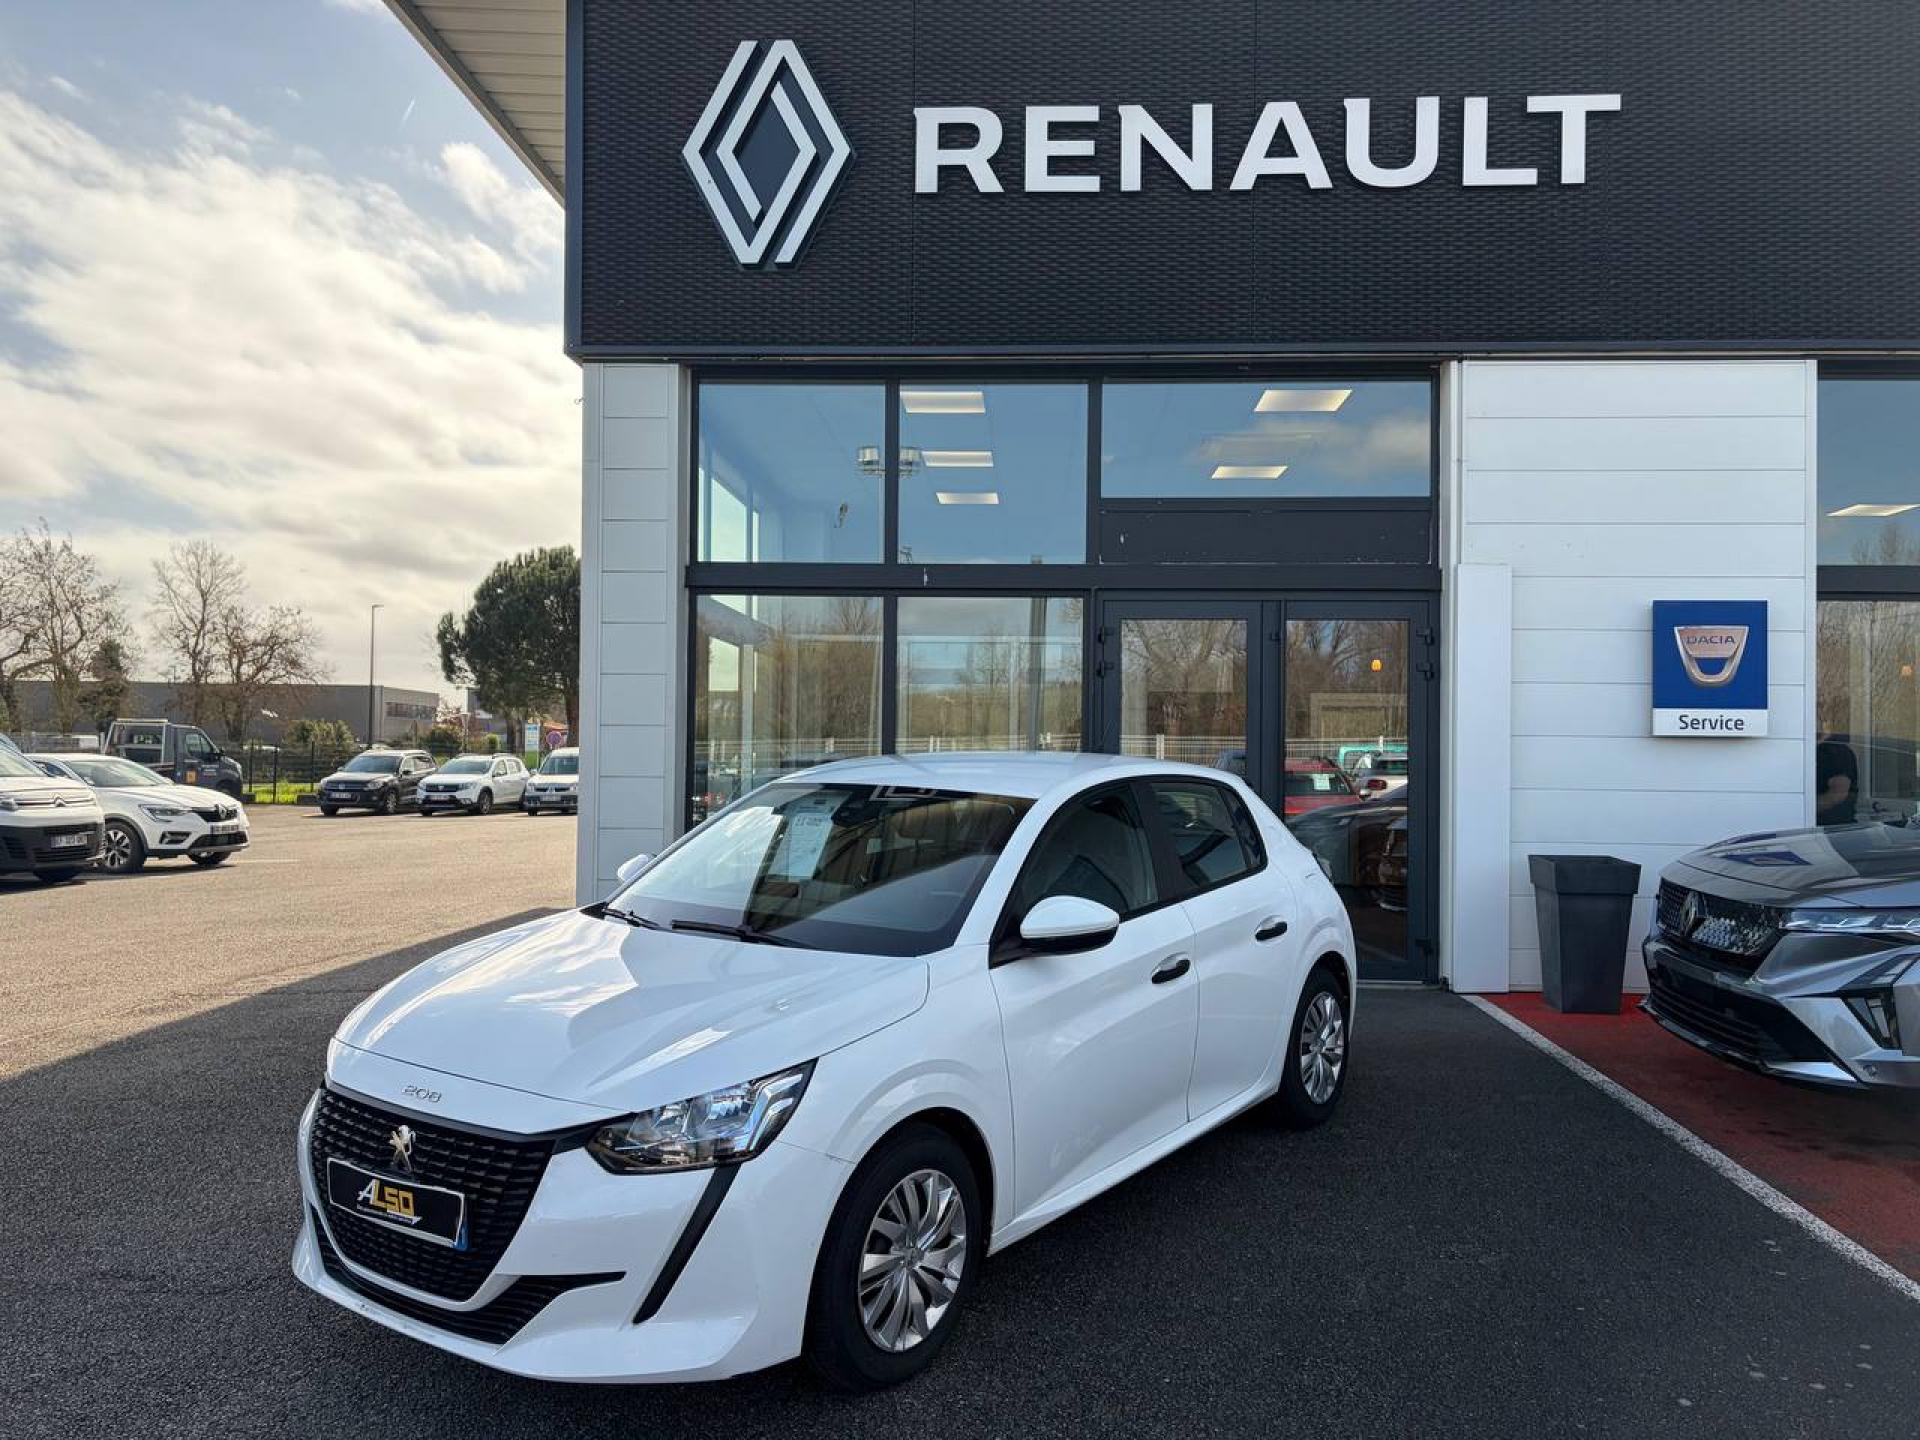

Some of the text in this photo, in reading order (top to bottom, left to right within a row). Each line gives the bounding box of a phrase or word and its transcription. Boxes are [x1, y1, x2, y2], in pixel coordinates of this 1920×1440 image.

[914, 94, 1622, 194] RENAULT
[1686, 635, 1736, 645] DACIA
[1678, 714, 1745, 731] Service
[402, 1085, 442, 1103] 208
